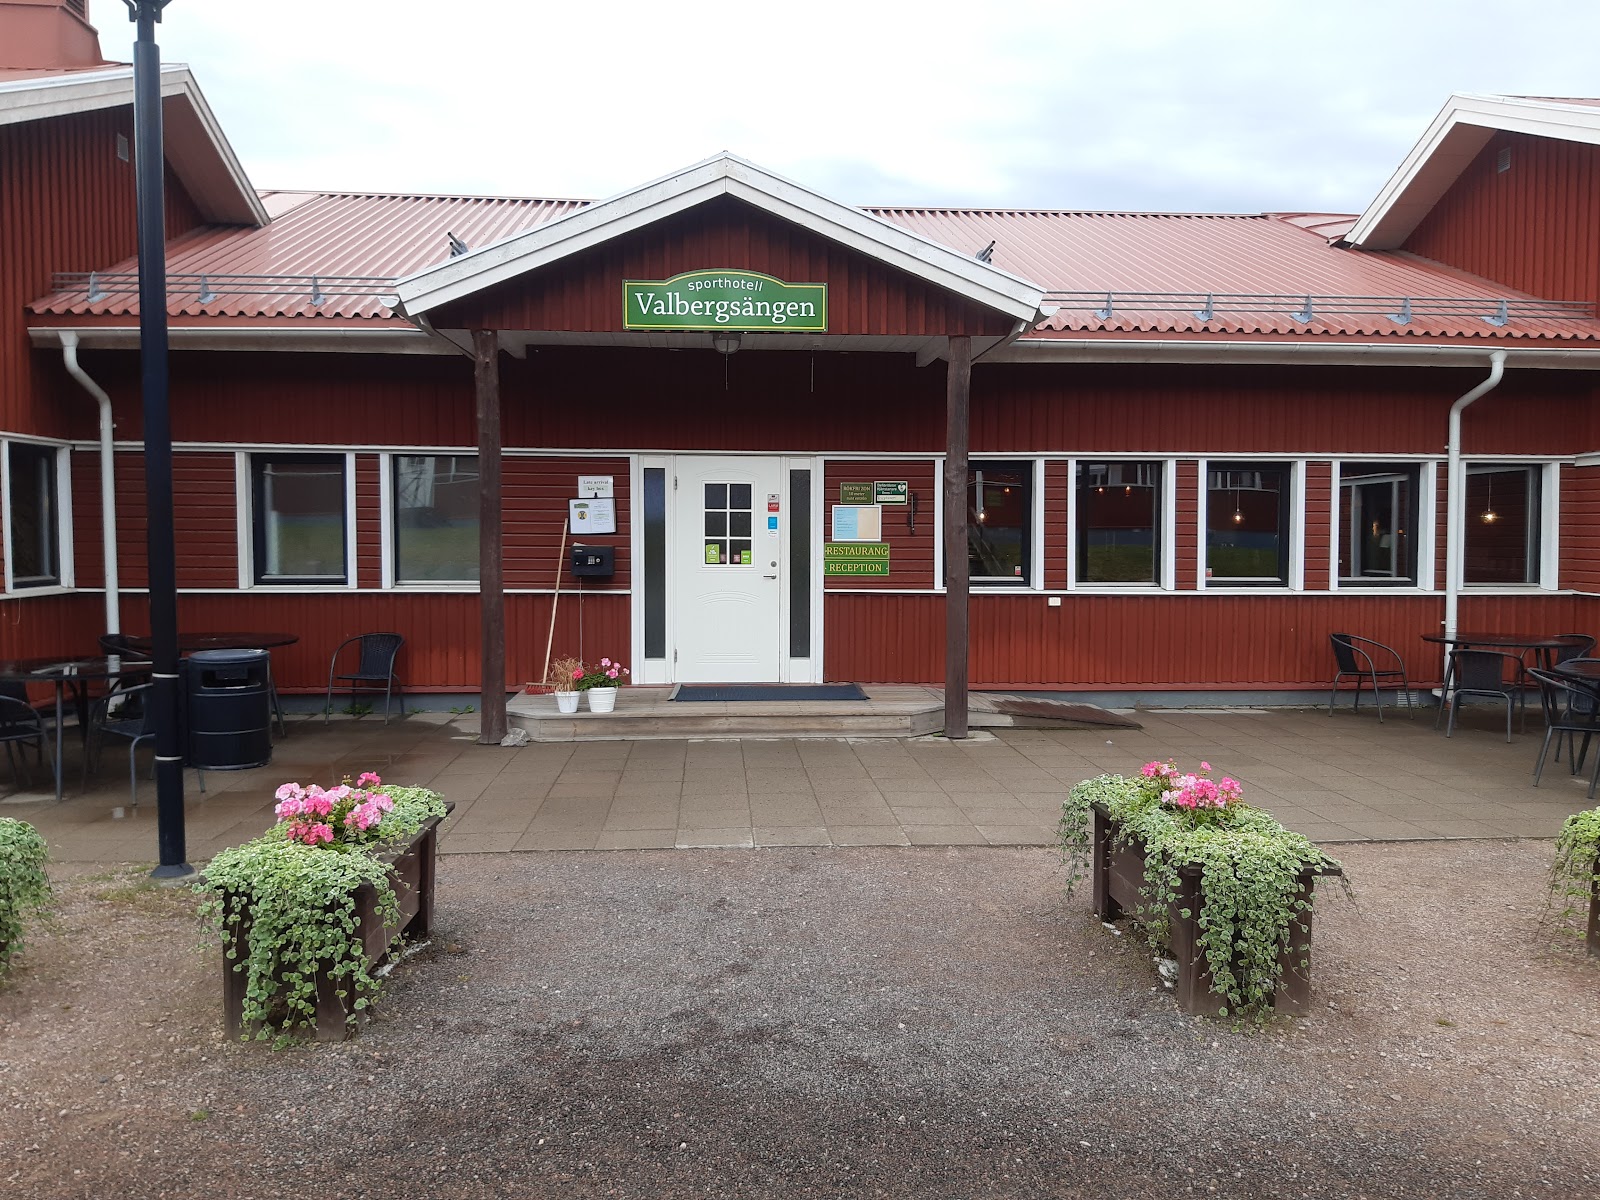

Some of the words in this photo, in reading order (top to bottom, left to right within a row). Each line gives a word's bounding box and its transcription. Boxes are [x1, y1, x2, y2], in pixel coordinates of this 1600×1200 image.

[688, 277, 763, 292] sporthotell
[635, 292, 816, 323] Valbergsängen
[826, 547, 887, 556] RESTAURANG
[829, 563, 882, 572] RECEPTION
